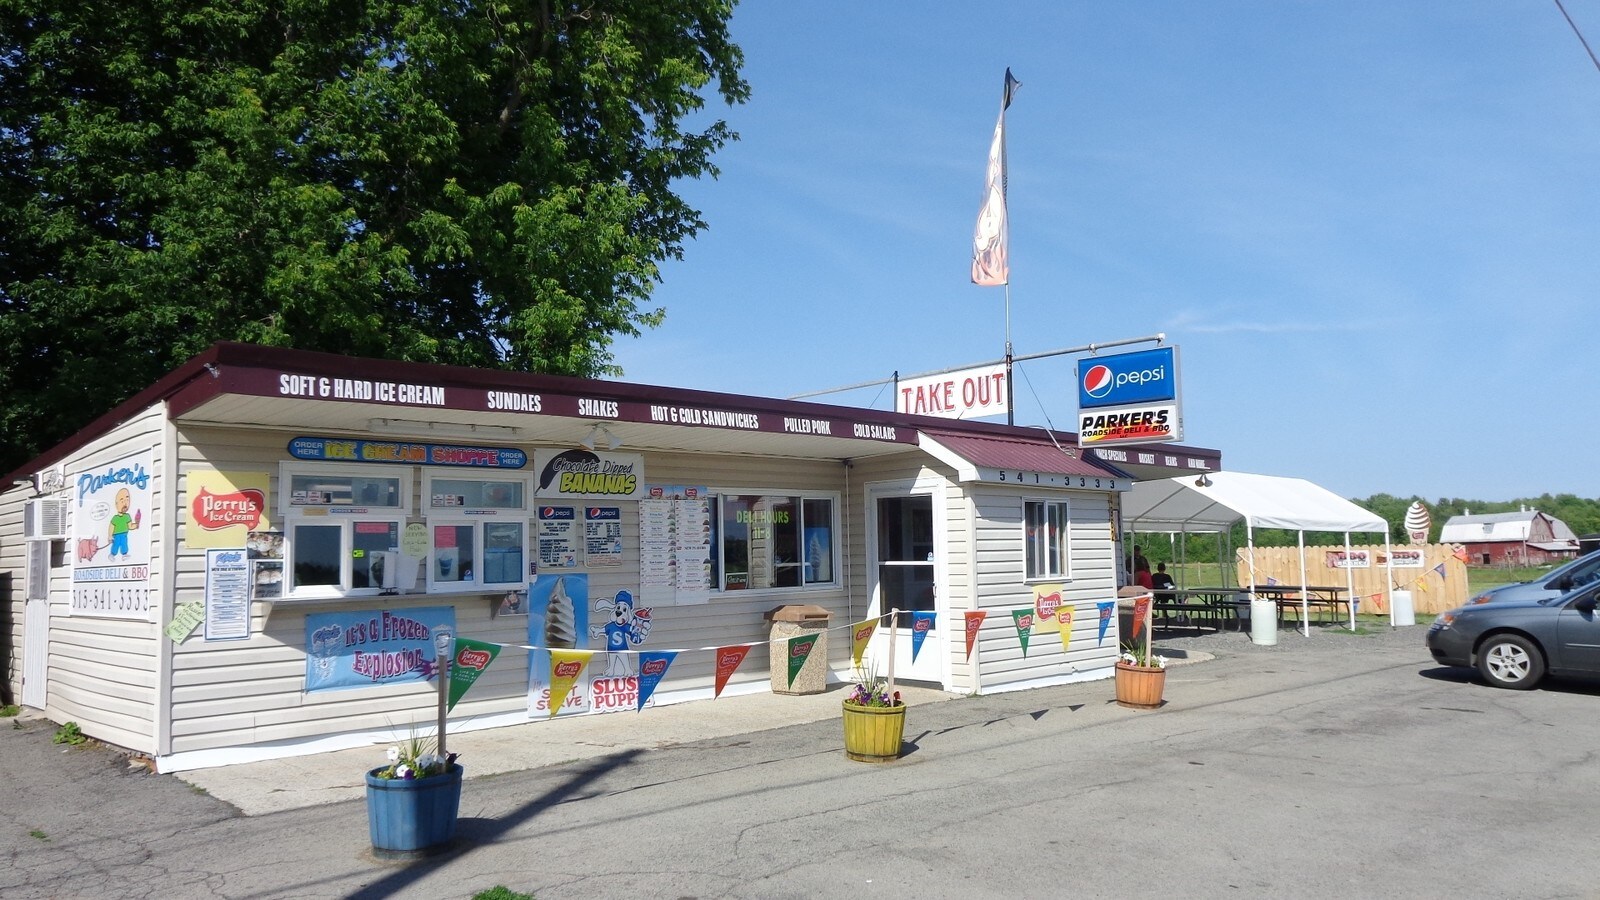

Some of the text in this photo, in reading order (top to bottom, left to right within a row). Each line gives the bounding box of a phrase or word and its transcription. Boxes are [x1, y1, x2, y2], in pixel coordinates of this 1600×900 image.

[1116, 364, 1164, 389] pepsi
[280, 373, 445, 405] SOFT & HARD ICE CREAM
[901, 373, 1005, 415] TAKE OUT
[487, 390, 542, 412] SUNDAES
[578, 398, 619, 418] SHAKES
[651, 405, 759, 429] HOT & COLD SANDWICHES
[784, 417, 831, 435] PULLED PORK
[1081, 409, 1169, 430] PARKER'S
[853, 423, 896, 440] COLD SALADS
[1081, 428, 1123, 438] ROADSIDE
[1123, 426, 1142, 434] DELI
[1152, 424, 1170, 433] BBQ
[294, 441, 323, 449] ORDER
[297, 448, 319, 456] HERE
[324, 441, 500, 466] ICE CREAM SHOPPE
[553, 457, 634, 477] Chocolate Dipped
[77, 463, 150, 508] Parker's
[559, 471, 637, 495] BANANAS
[201, 495, 256, 518] Perry's
[209, 510, 254, 522] Ice Cream
[736, 511, 789, 524] DELI HOURS
[73, 566, 148, 581] ROADSIDE DELI & BBQ
[345, 622, 366, 647] It's
[369, 617, 379, 641] a
[381, 609, 430, 640] Frozen
[612, 631, 623, 646] S
[352, 647, 424, 682] Explosion
[462, 650, 486, 662] Perry's
[557, 663, 578, 672] Perry's
[541, 685, 578, 699] ST
[594, 692, 650, 709] PUPP
[536, 696, 582, 710] SVE
